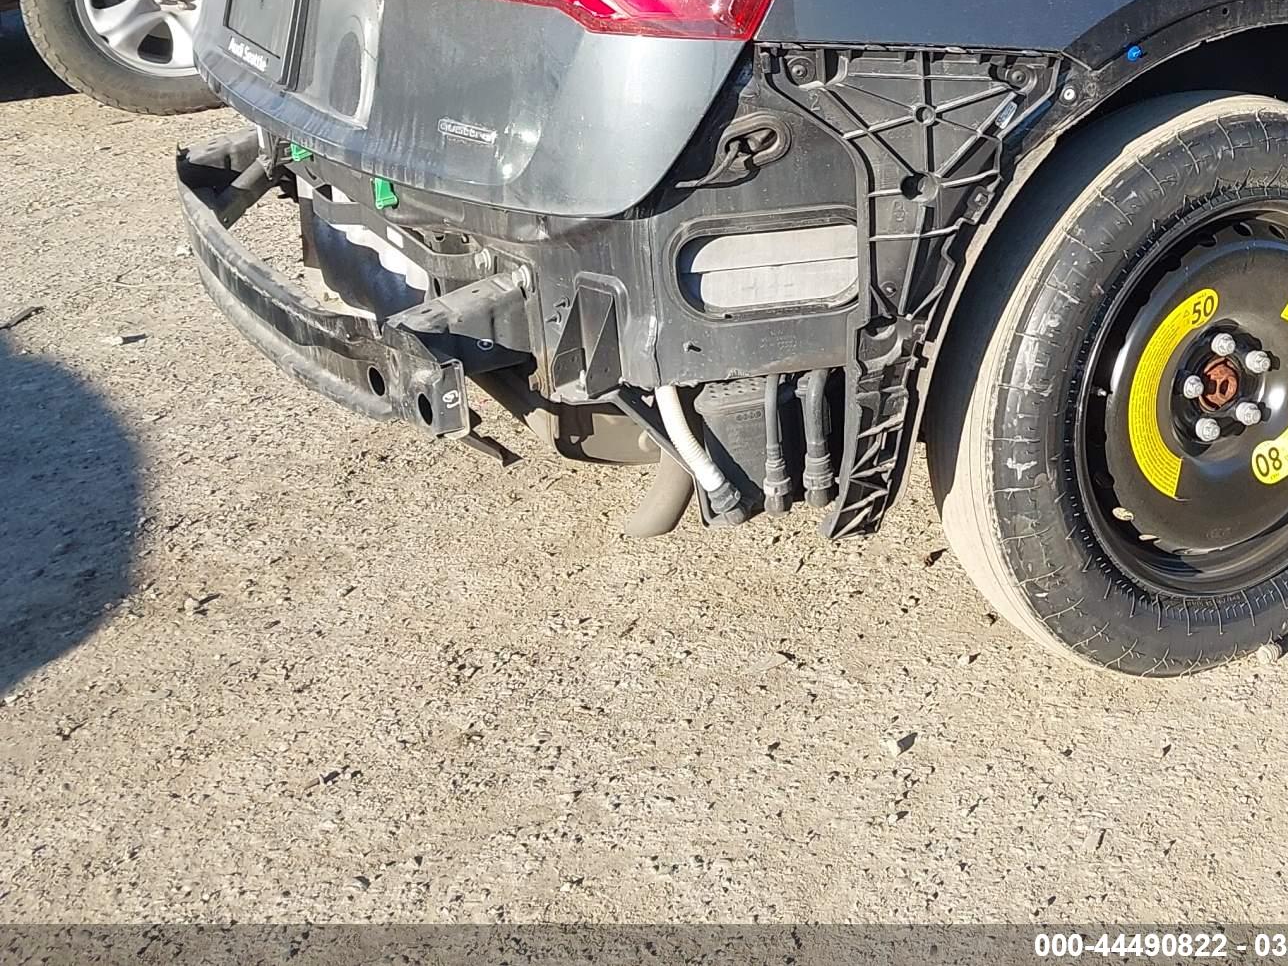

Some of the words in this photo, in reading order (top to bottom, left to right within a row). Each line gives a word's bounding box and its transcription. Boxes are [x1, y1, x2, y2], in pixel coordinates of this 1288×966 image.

[228, 37, 245, 58] Audi
[242, 45, 267, 72] Seattle
[1191, 295, 1215, 325] 50
[1255, 446, 1282, 478] 80
